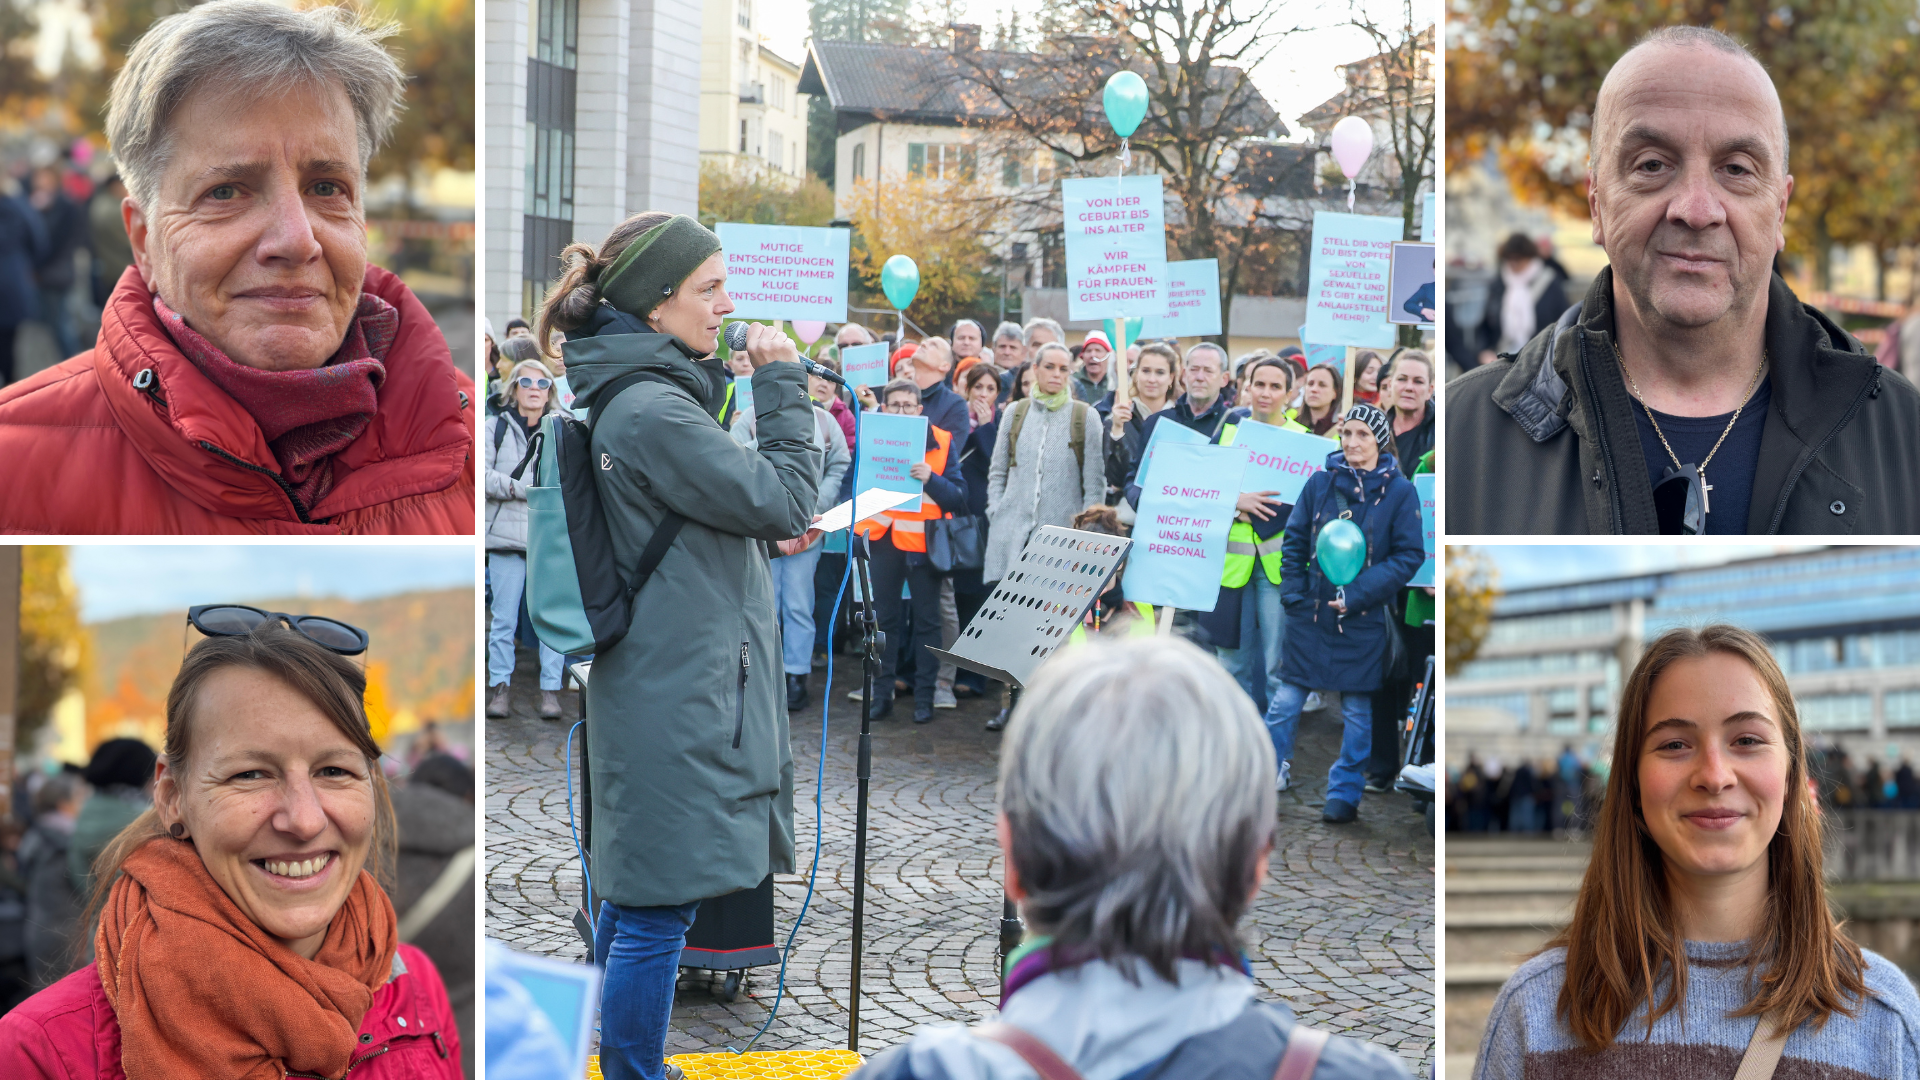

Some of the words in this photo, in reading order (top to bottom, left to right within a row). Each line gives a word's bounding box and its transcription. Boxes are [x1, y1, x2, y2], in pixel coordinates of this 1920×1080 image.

[1086, 199, 1112, 207] VON
[1116, 197, 1140, 206] DER
[1079, 211, 1126, 221] GEBURT
[1131, 210, 1149, 218] BIS
[1085, 226, 1104, 234] INS
[1108, 223, 1144, 233] ALTER
[1324, 237, 1349, 246] STELL
[761, 243, 803, 252] MUTIGE
[1322, 247, 1335, 255] DU
[1338, 249, 1357, 257] BIST
[729, 253, 834, 266] ENTSCHEIDUNGEN
[1104, 251, 1128, 260] WIR
[728, 267, 755, 275] SIND
[758, 268, 794, 277] NICHT
[797, 270, 835, 279] IMMER
[1088, 264, 1146, 274] KÄMPFEN
[1329, 270, 1381, 280] SEXUELLER
[762, 280, 799, 290] KLUGE
[1078, 277, 1102, 289] FÜR
[1105, 277, 1157, 287] FRAUEN-
[1323, 280, 1361, 289] GEWALT
[728, 291, 833, 304] ENTSCHEIDUNGEN
[1080, 290, 1156, 302] GESUNDHEIT
[1321, 290, 1332, 298] ES
[1358, 294, 1385, 302] KEINE
[846, 359, 884, 372] #sonicht
[1162, 485, 1179, 496] SO
[1181, 488, 1220, 499] NICHT!
[1157, 515, 1190, 526] NICHT
[1192, 519, 1211, 528] MIT
[1159, 531, 1180, 540] UNS
[1183, 532, 1202, 542] ALS
[1149, 543, 1206, 558] PERSONAL
